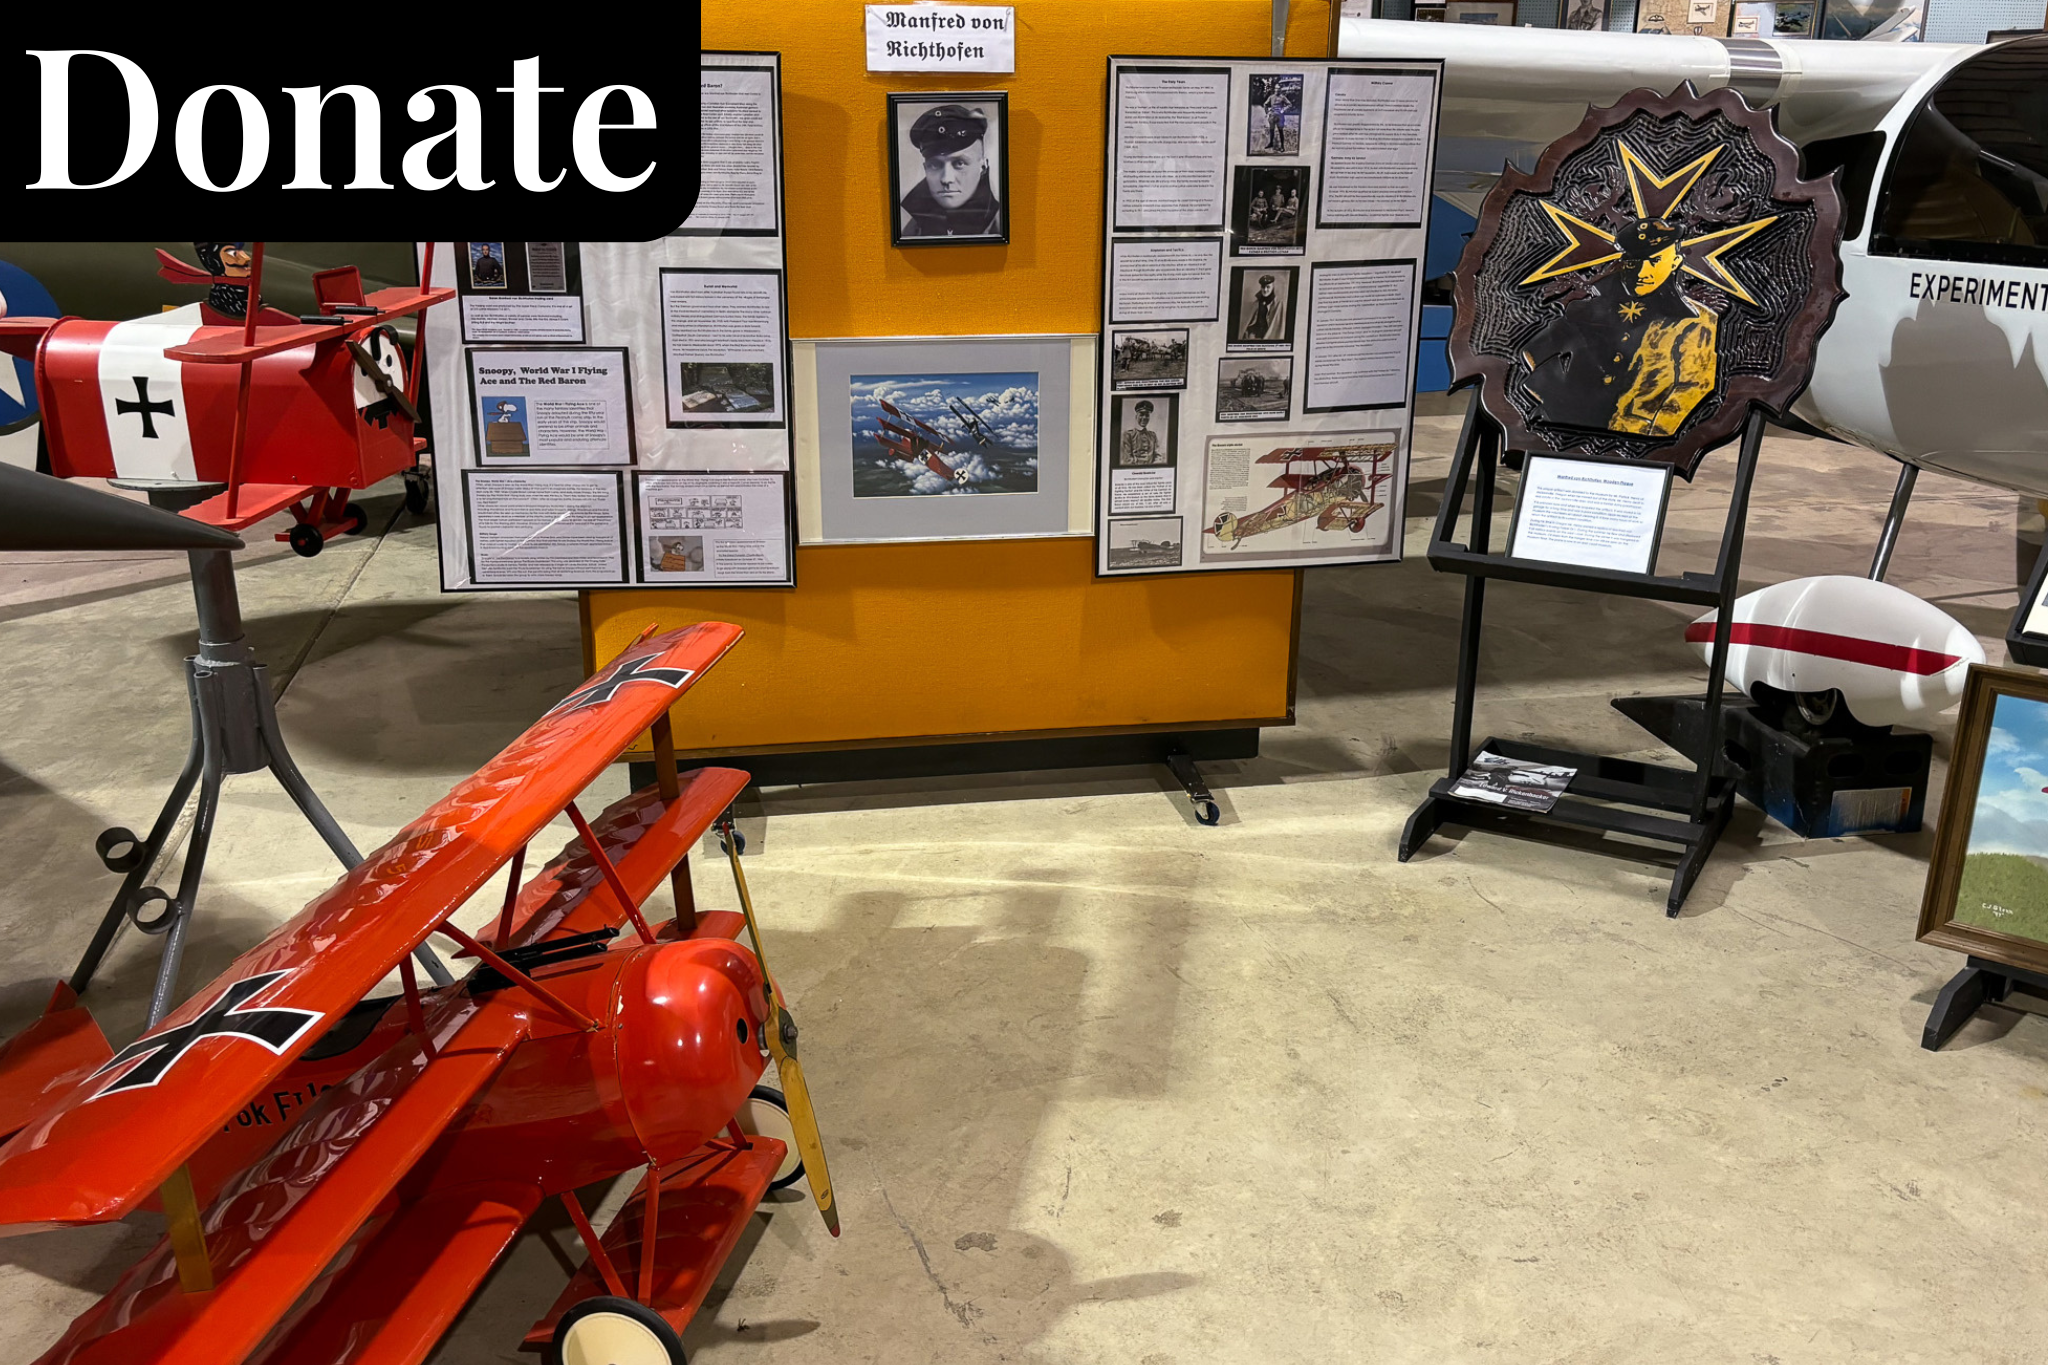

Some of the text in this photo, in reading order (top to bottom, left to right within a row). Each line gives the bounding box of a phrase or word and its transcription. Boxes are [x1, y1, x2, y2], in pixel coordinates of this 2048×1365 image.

[886, 11, 1004, 32] Manfred von
[886, 40, 984, 61] Richthofen
[1910, 272, 2048, 312] EXPERIMENT
[478, 366, 516, 376] Snoopy,
[578, 367, 608, 375] Flying
